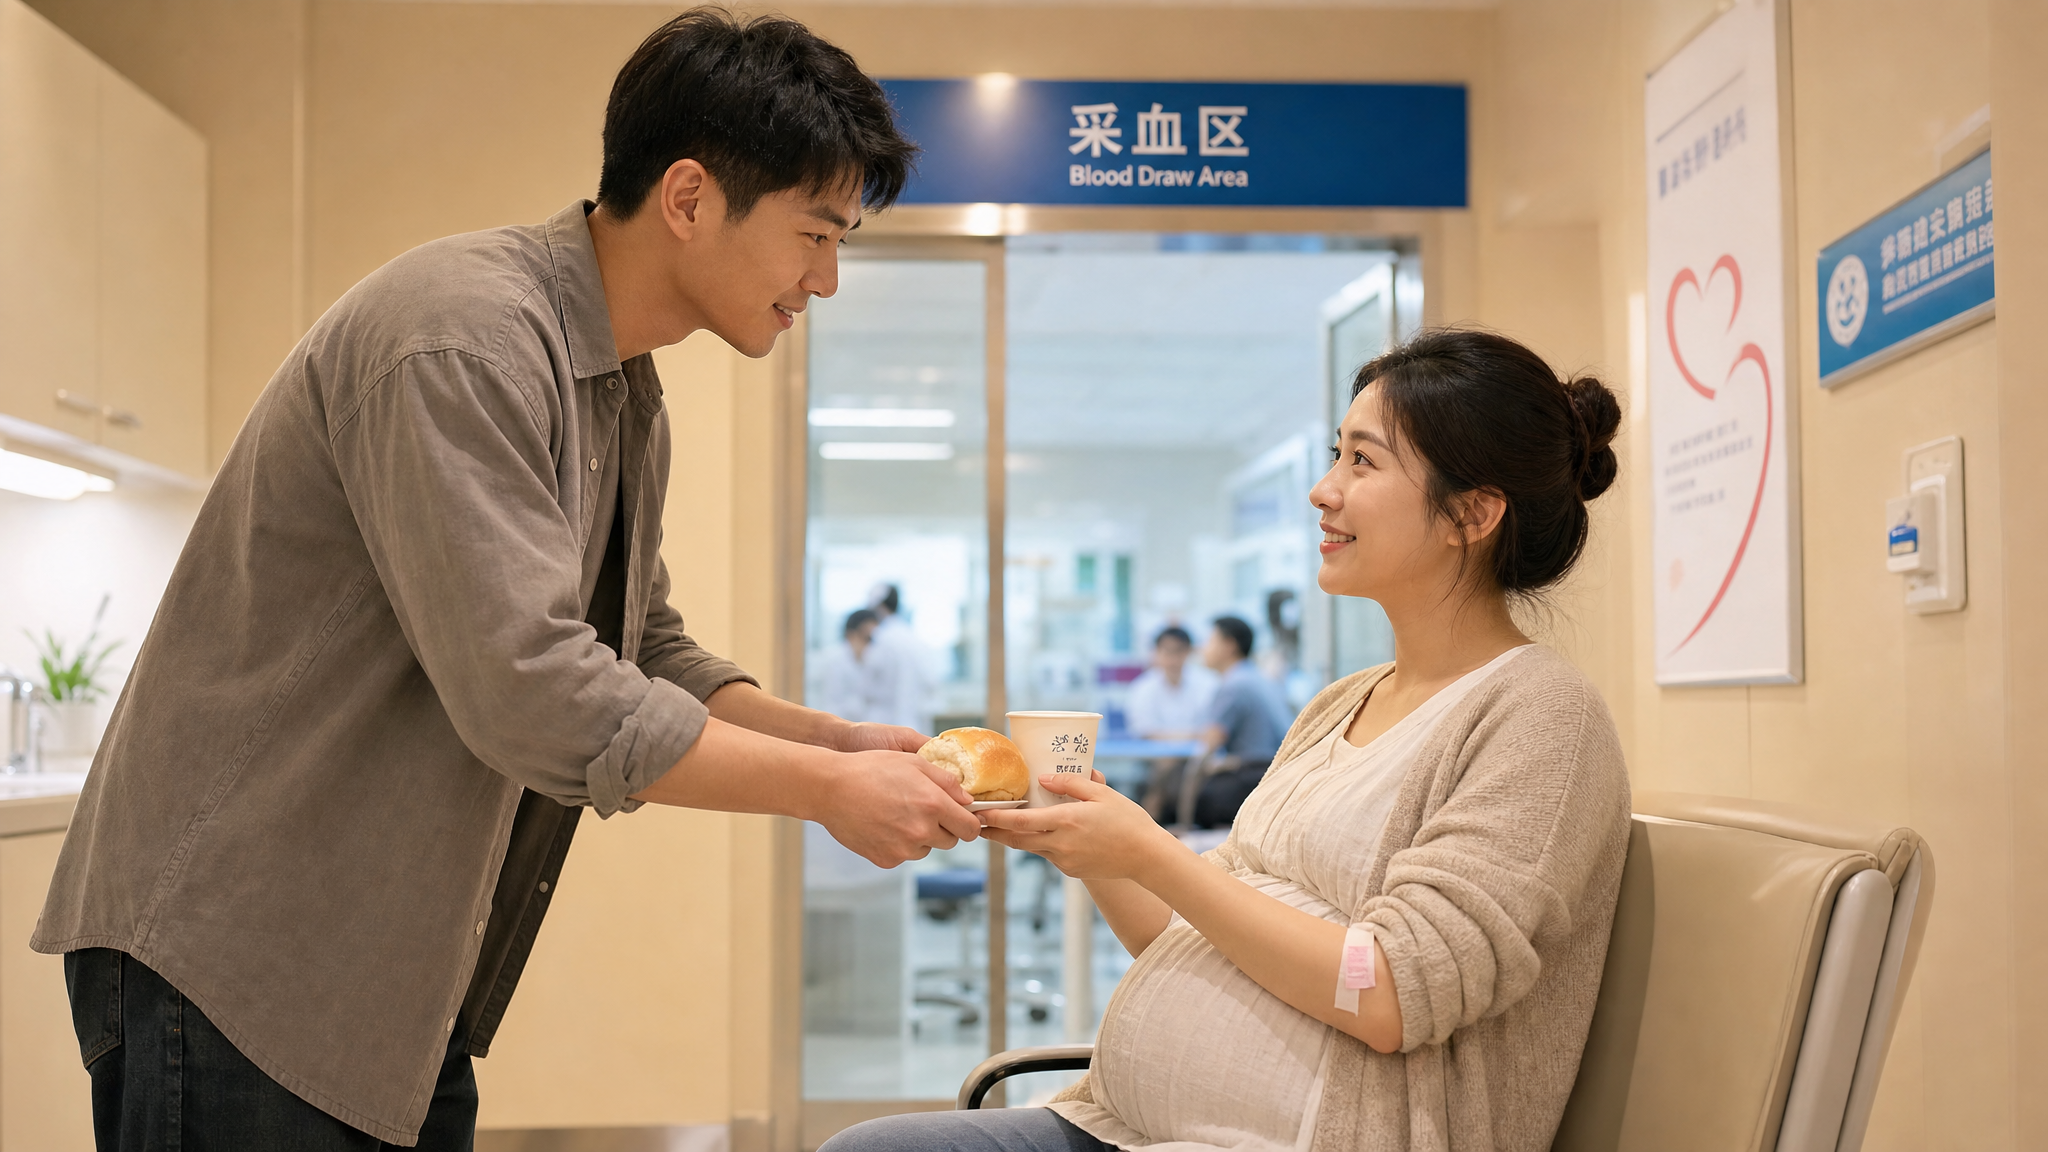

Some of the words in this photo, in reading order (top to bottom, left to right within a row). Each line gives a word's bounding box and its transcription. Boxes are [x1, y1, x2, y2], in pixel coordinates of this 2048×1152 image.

[1068, 102, 1250, 158] 采血区
[1069, 164, 1133, 187] Blood
[1138, 165, 1195, 187] Draw
[1197, 165, 1249, 187] Area
